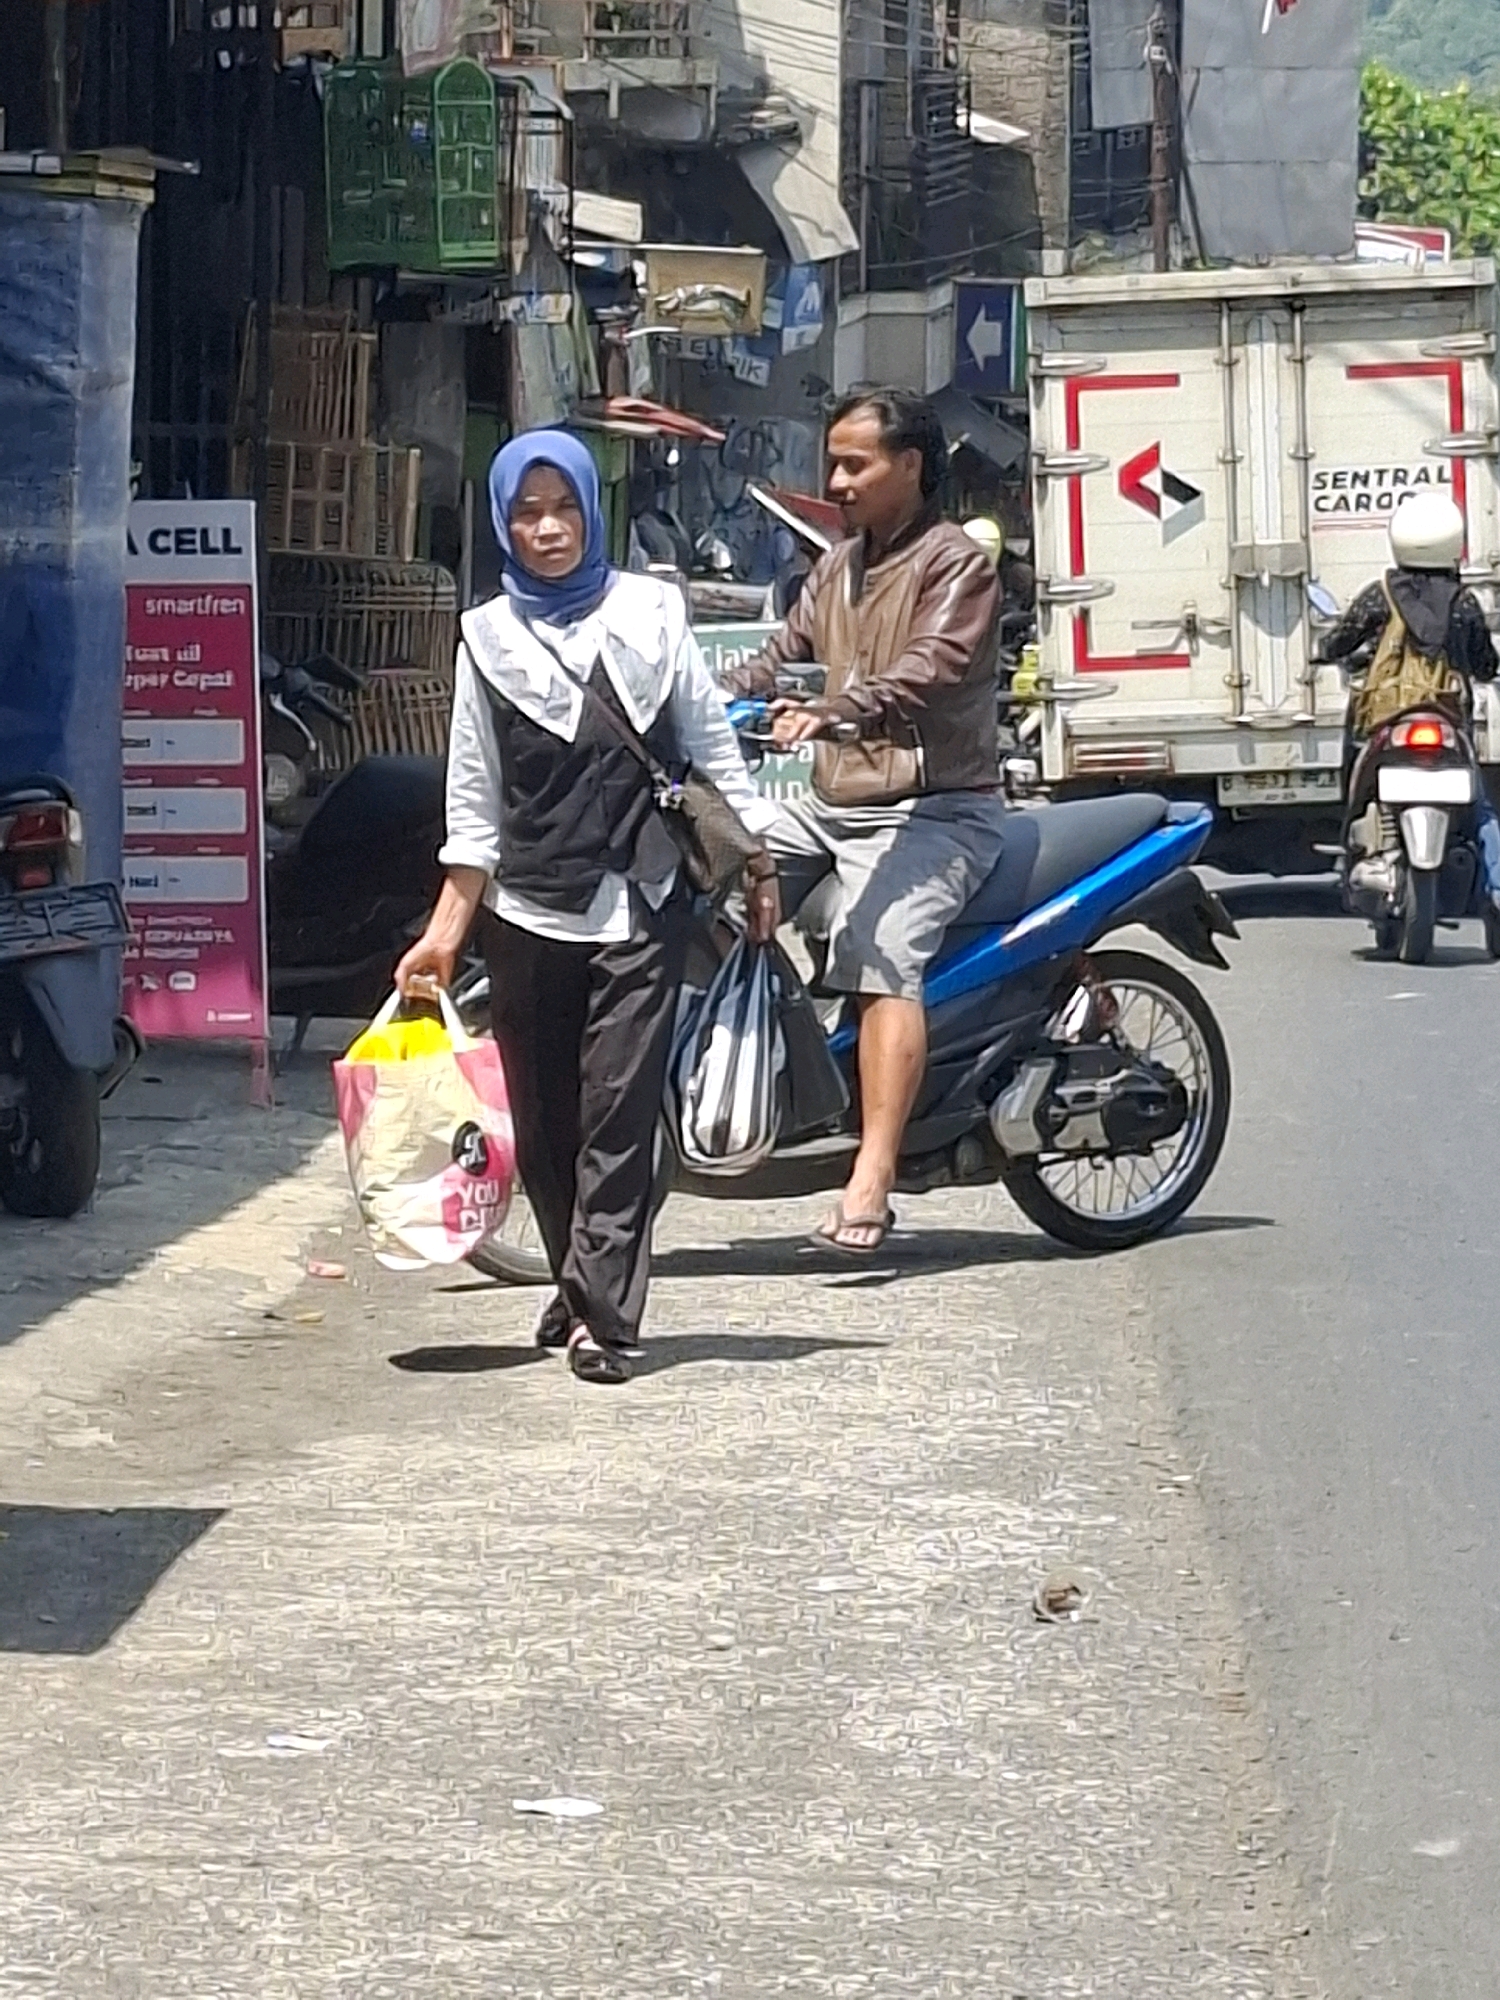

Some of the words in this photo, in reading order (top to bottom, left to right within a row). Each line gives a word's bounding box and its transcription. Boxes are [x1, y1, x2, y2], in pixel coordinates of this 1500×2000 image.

[1312, 465, 1452, 490] SENTRAL
[147, 527, 242, 556] CELL
[145, 594, 245, 615] smartfren
